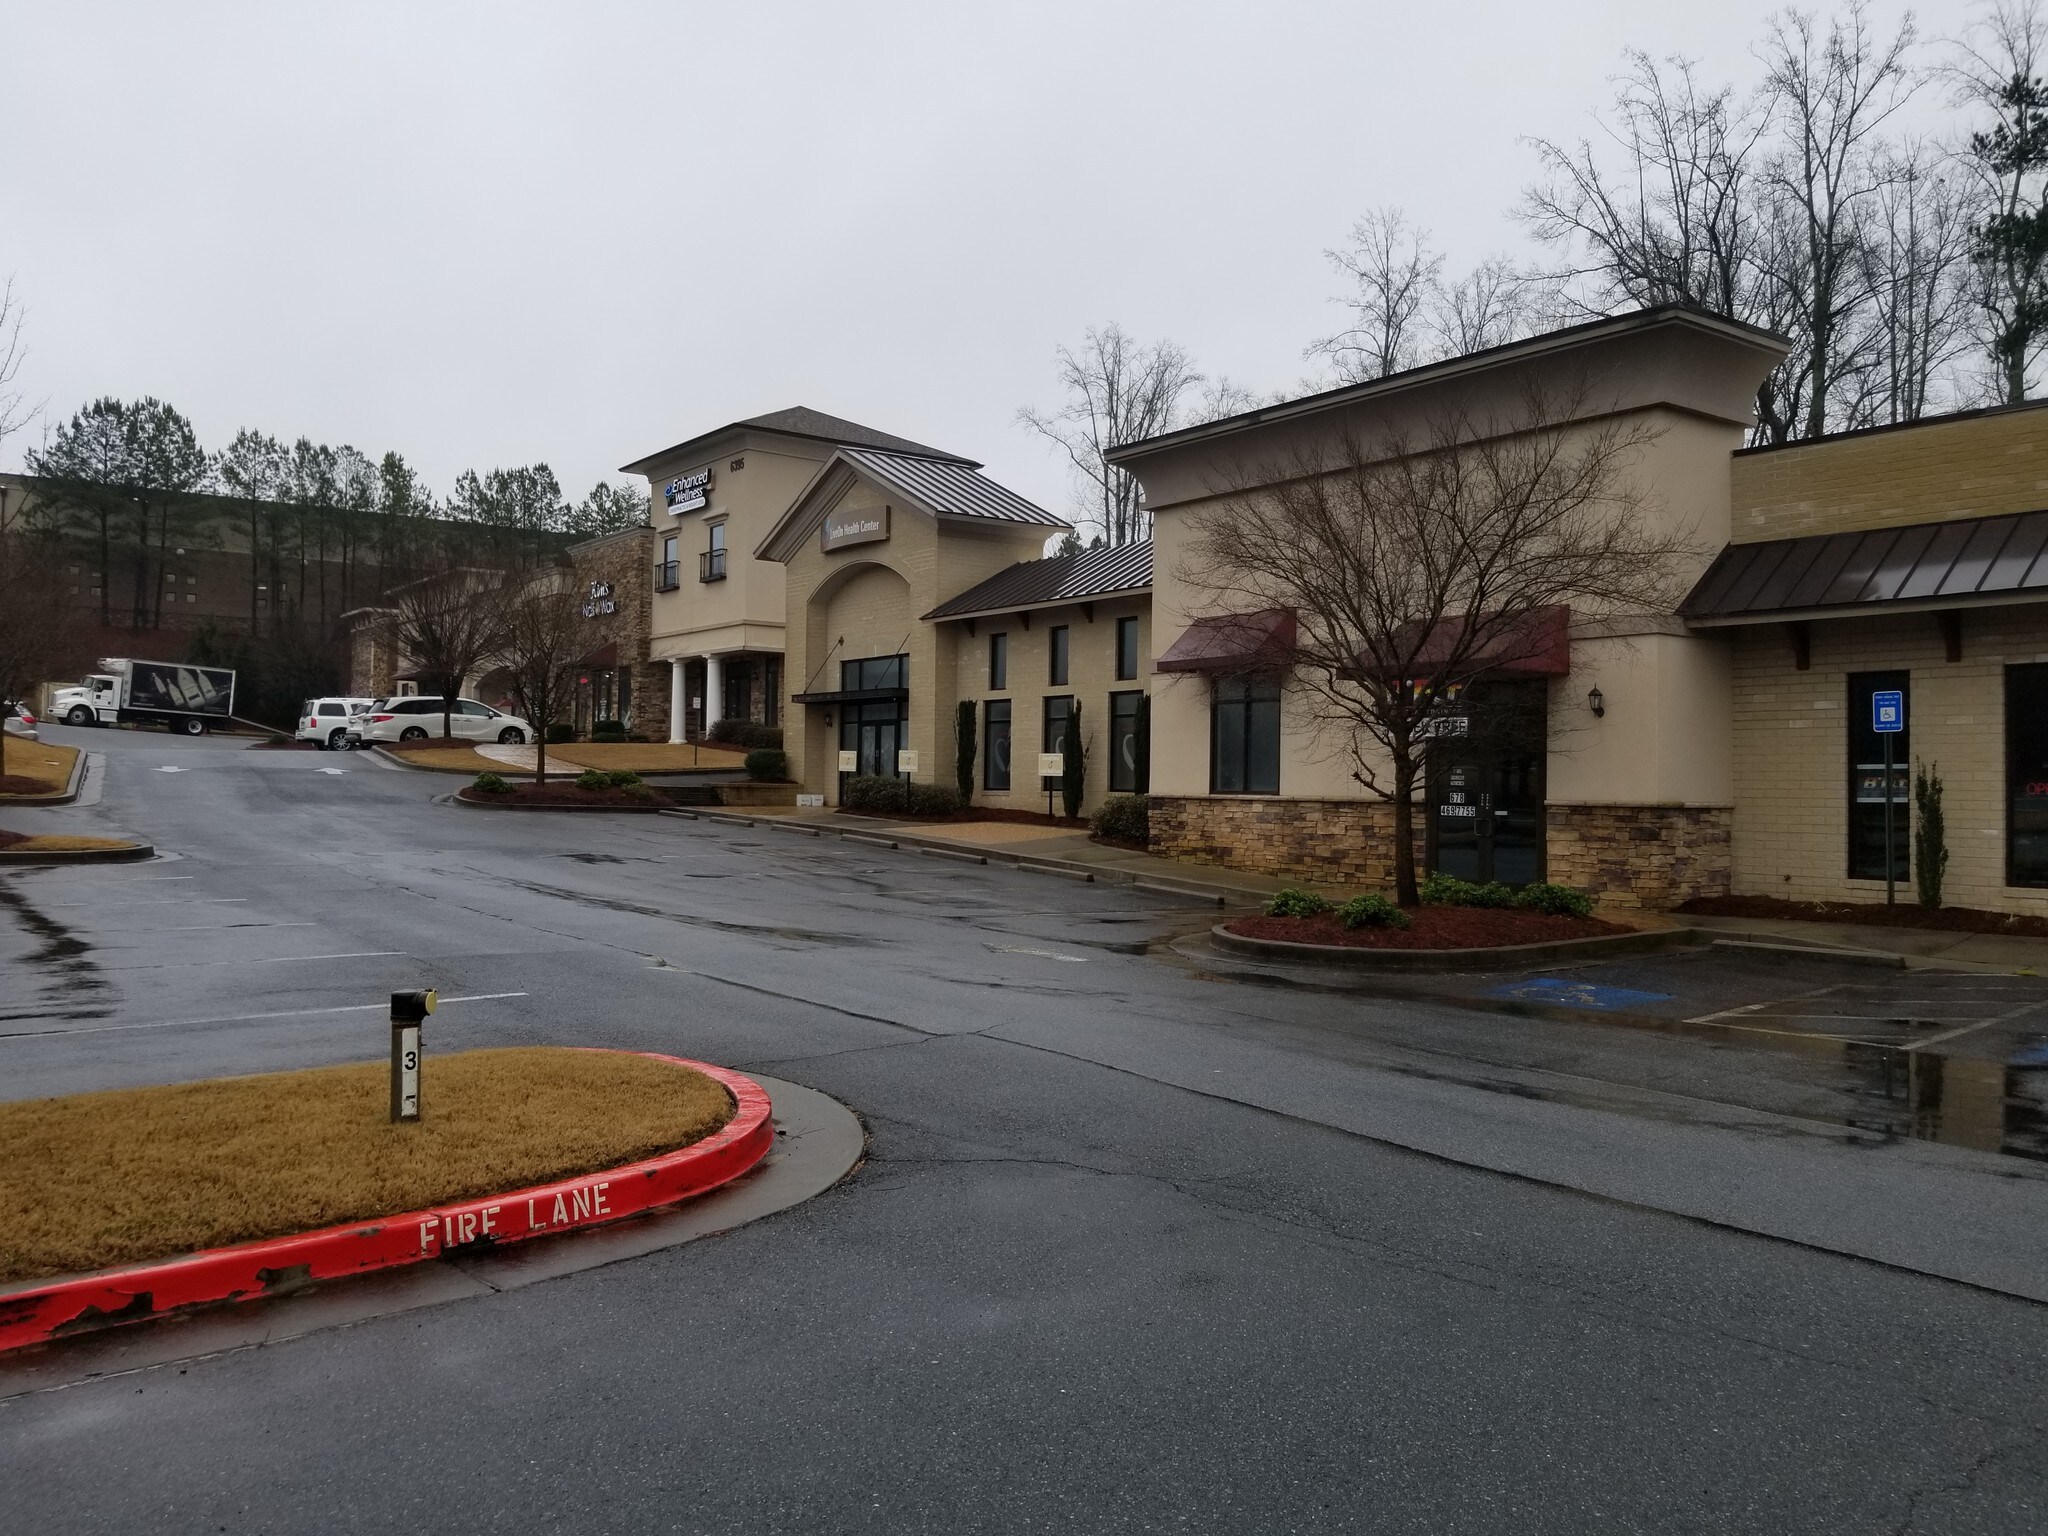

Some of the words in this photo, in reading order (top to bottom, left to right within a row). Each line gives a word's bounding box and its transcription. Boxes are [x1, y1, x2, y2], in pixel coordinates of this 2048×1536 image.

[730, 457, 745, 473] 6395
[672, 467, 709, 493] Enhanced
[674, 487, 703, 504] Wellness
[844, 521, 860, 536] Health
[860, 520, 880, 533] Center
[1450, 793, 1465, 803] 678
[404, 1051, 417, 1071] 3
[420, 1206, 500, 1256] FIRE
[528, 1182, 611, 1230] LANE
